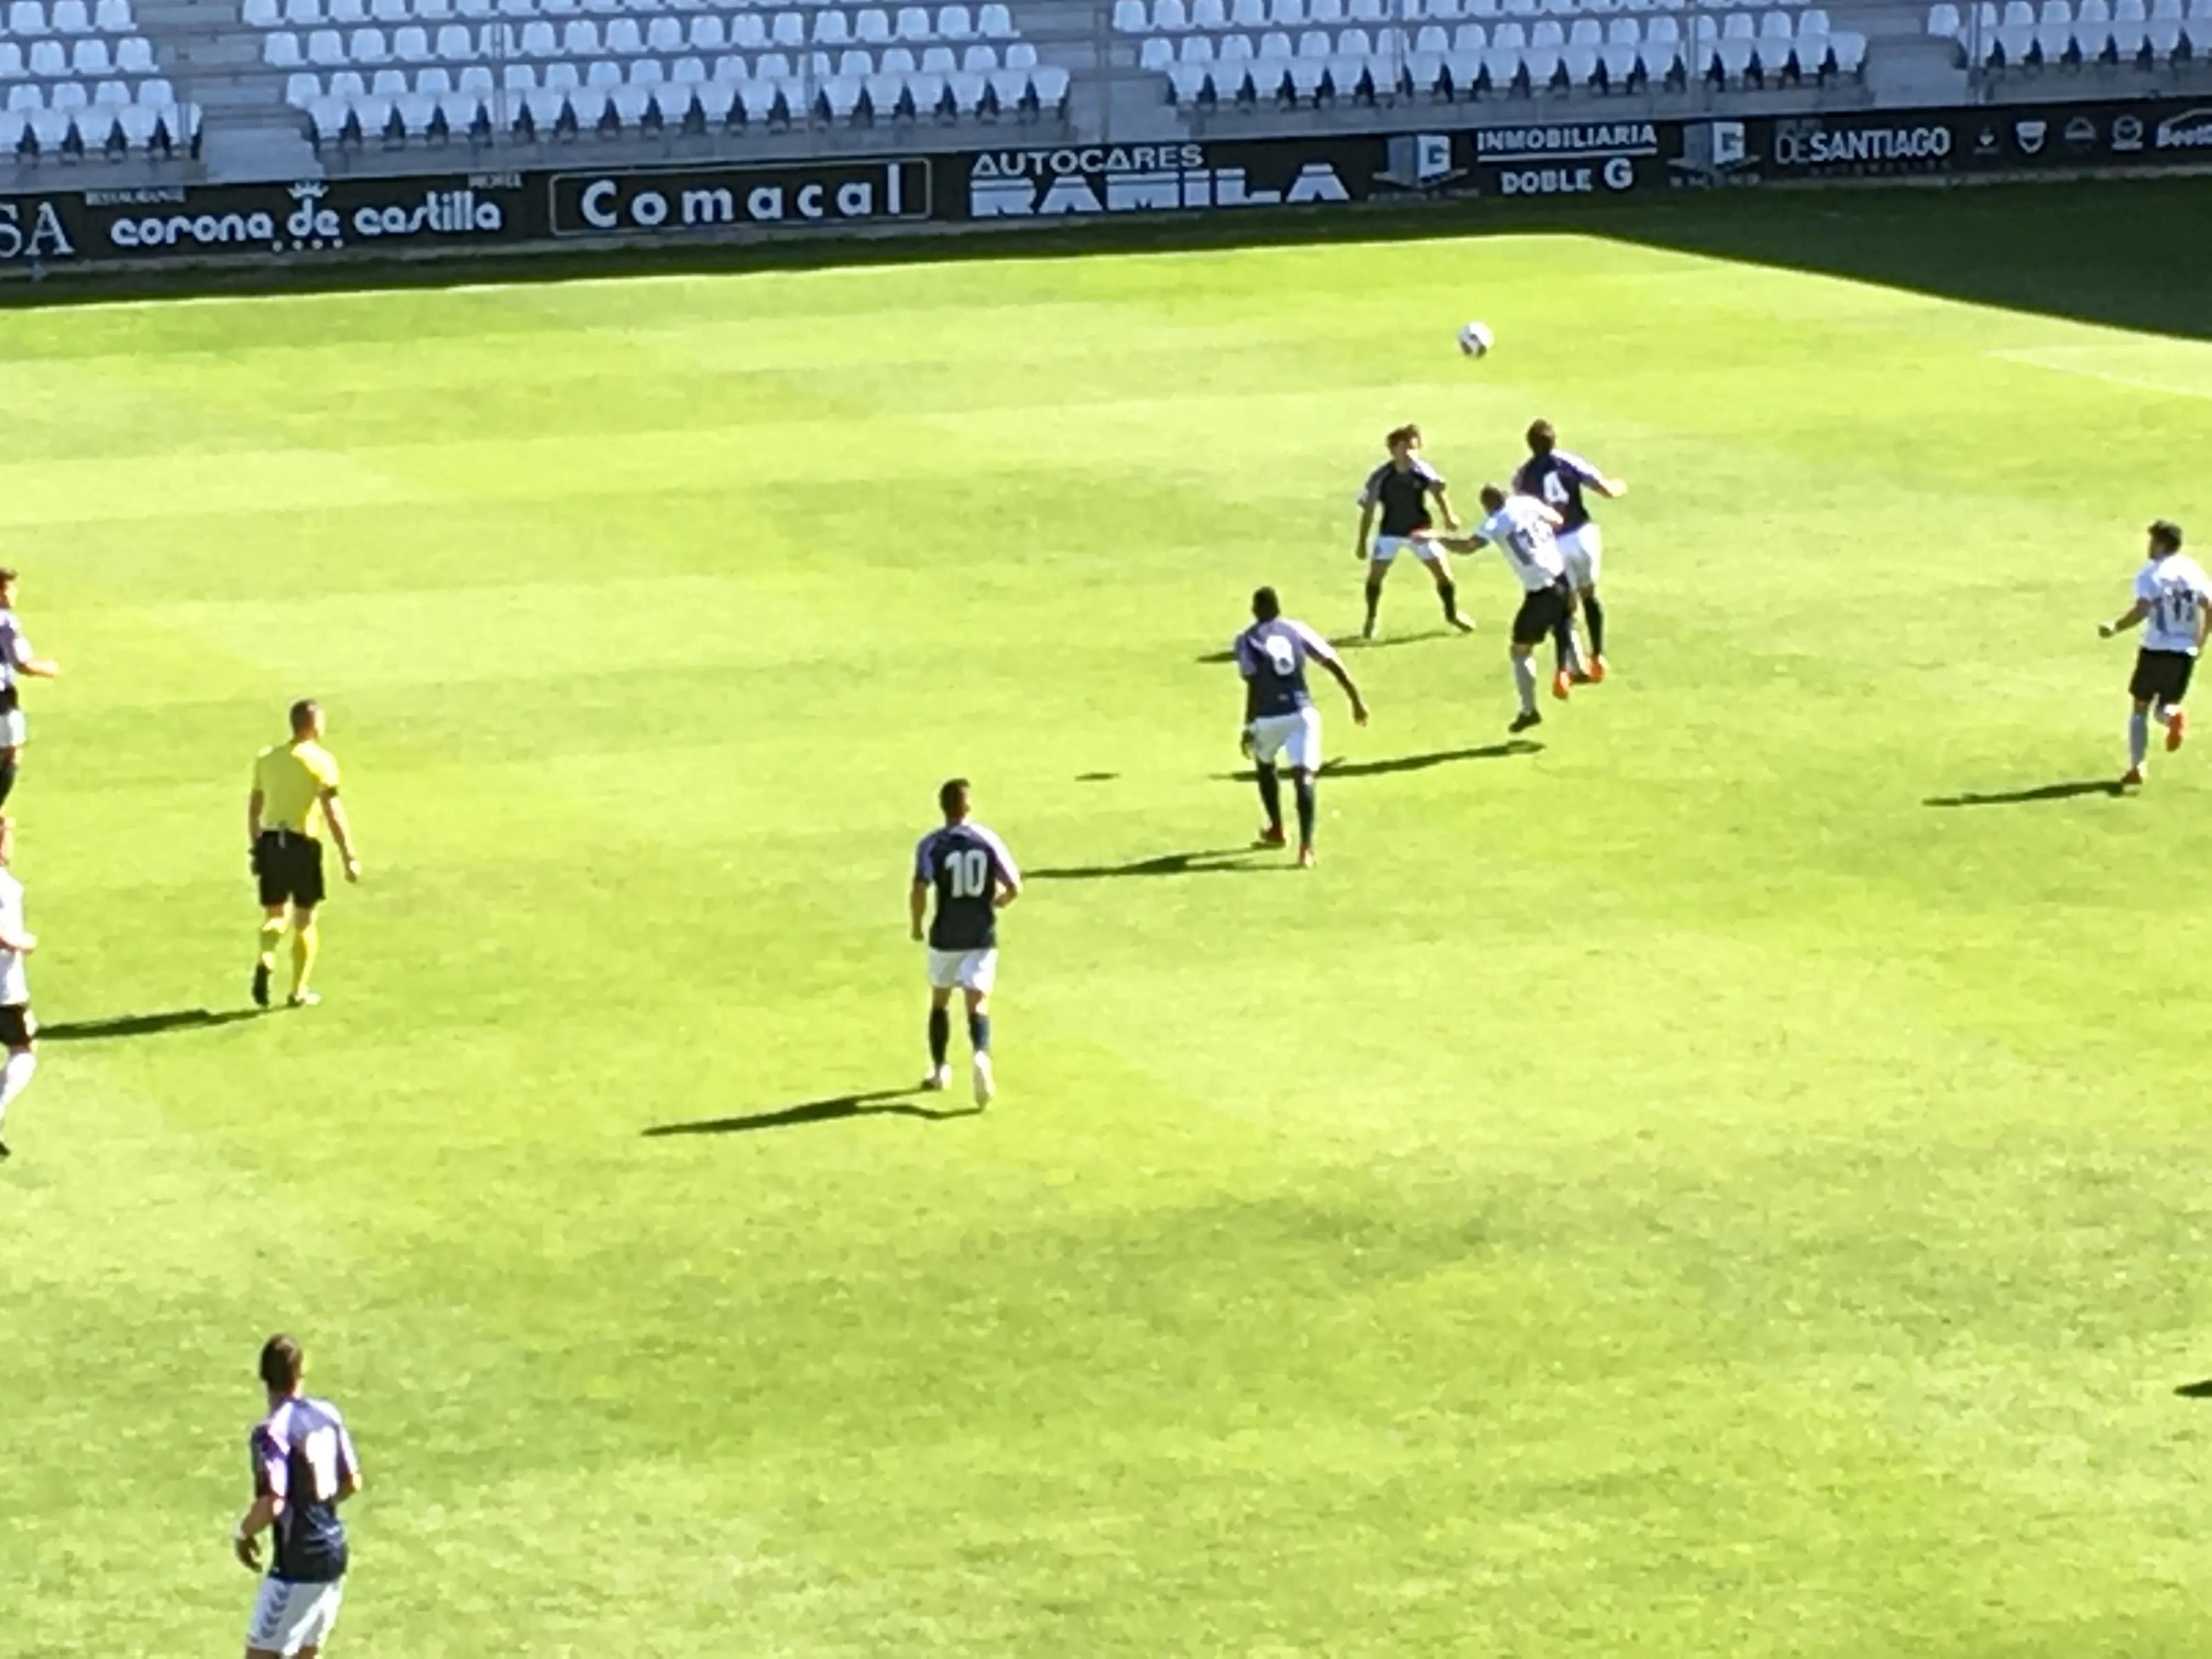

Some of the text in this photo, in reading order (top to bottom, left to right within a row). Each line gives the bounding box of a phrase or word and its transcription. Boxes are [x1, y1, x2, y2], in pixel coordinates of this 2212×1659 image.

[1477, 124, 1657, 151] INMOBILIARIA
[970, 144, 1204, 176] AUTOCARES
[1502, 158, 1633, 194] DOBLE G
[581, 163, 901, 228] Comacal
[970, 163, 1350, 217] RAMILA
[111, 190, 501, 246] corona de castilla
[1543, 471, 1569, 504] 4
[945, 849, 988, 898] 10
